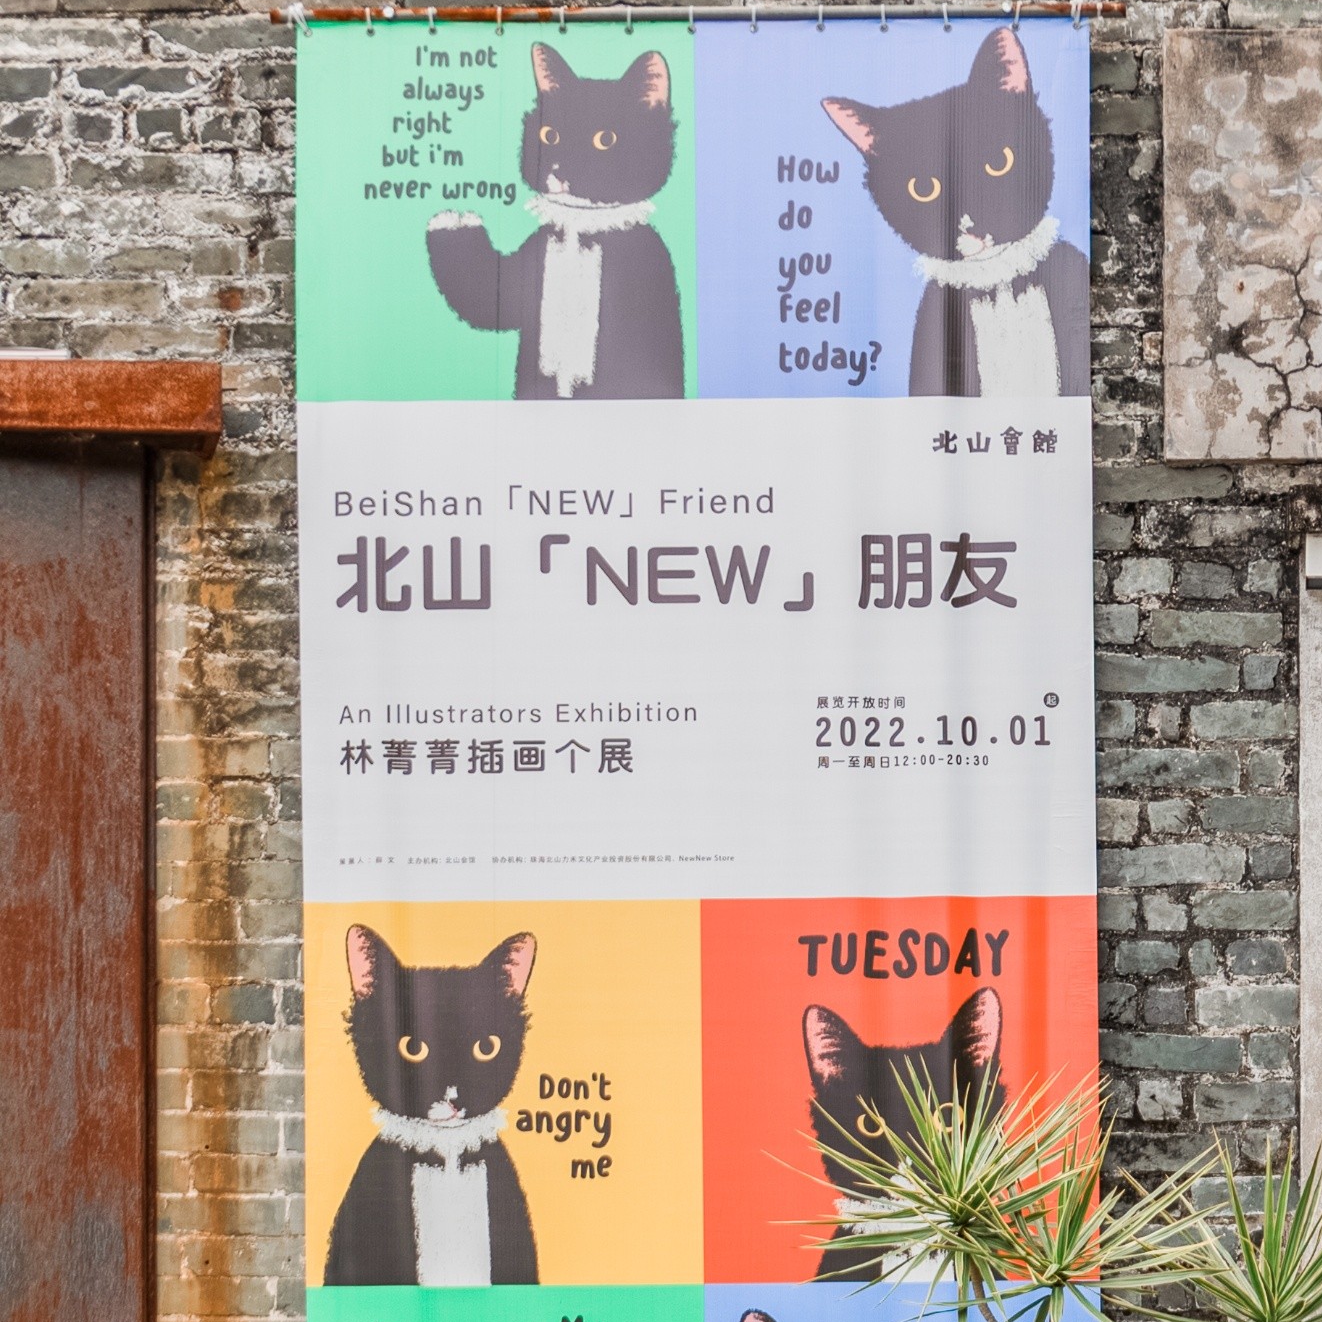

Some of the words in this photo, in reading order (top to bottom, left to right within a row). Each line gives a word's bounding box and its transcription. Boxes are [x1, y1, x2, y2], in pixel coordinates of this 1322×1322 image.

[415, 45, 450, 68] I'm
[459, 45, 498, 69] not
[402, 76, 486, 106] always
[392, 110, 453, 140] right
[382, 144, 420, 168] but
[429, 143, 464, 167] i'm
[777, 155, 840, 184] How
[364, 179, 432, 200] never
[442, 180, 517, 206] wrong
[778, 199, 813, 231] do
[776, 252, 832, 293] you
[777, 289, 841, 324] feel
[779, 340, 883, 387] today?
[932, 426, 1058, 456] 北山會館
[334, 489, 482, 517] BeiShan
[660, 486, 774, 515] Friend
[339, 705, 371, 725] An
[386, 703, 542, 725] Illustrators
[556, 701, 697, 723] Exhibition
[816, 695, 906, 710] 展览开放时间
[815, 714, 1051, 748] 2022.10.01
[339, 738, 634, 776] 林菁菁插画个展
[715, 853, 735, 864] Store
[797, 927, 1010, 980] TUESDAY
[539, 1072, 612, 1102] Don't
[515, 1109, 612, 1149] angry
[570, 1155, 613, 1180] me
